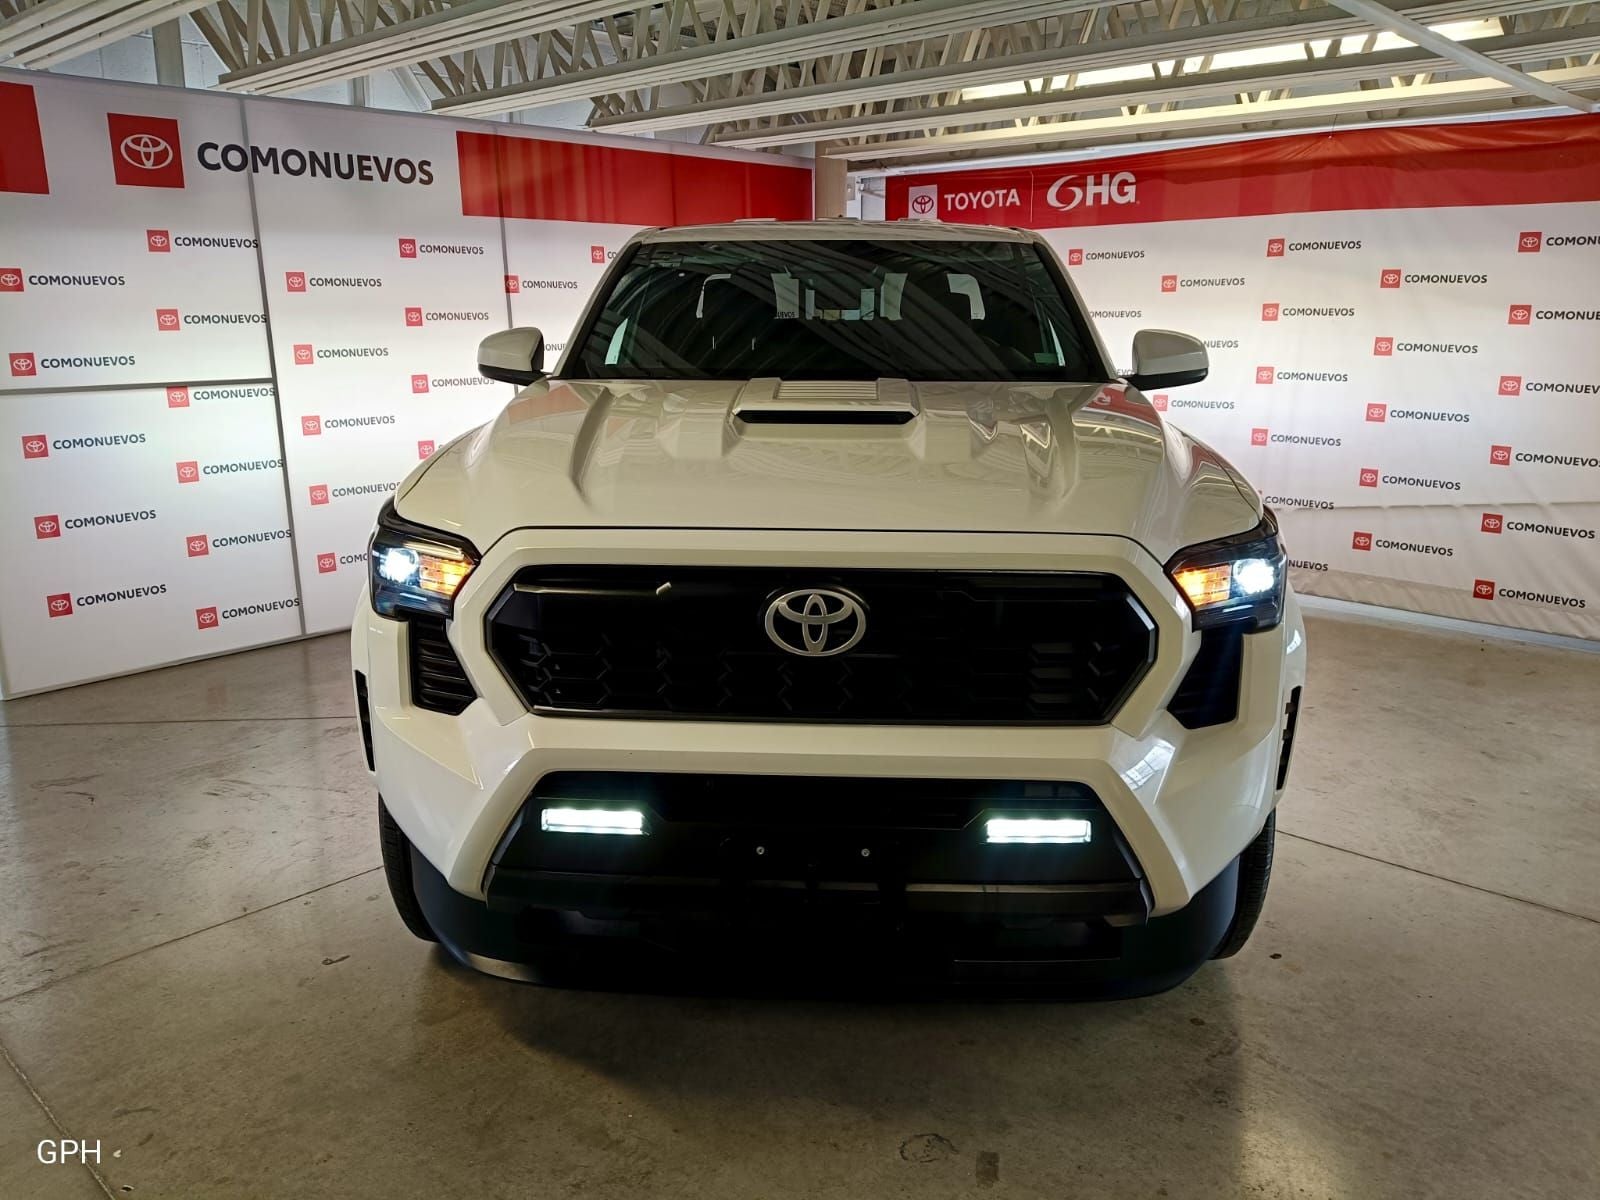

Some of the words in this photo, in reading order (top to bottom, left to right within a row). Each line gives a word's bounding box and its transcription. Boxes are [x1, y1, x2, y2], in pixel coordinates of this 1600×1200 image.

[198, 140, 434, 187] COMONUEVOS
[943, 188, 1021, 211] TOYOTA
[174, 236, 259, 250] COMONUEVOS
[419, 244, 485, 256] COMONUEVOS
[1288, 240, 1362, 252] COMONUEVOS
[1085, 250, 1145, 262] COMONUEVOS
[28, 274, 126, 287] COMONUEVOS
[309, 278, 383, 288] COMONUEVOS
[522, 280, 578, 290] COMONUEVOS
[1180, 277, 1245, 288] COMONUEVOS
[1404, 273, 1488, 286] COMONUEVOS
[425, 312, 490, 322] COMONUEVOS
[1282, 307, 1355, 317] COMONUEVOS
[184, 314, 267, 326] COMONUEVOS
[316, 347, 390, 359] COMONUEVOS
[1397, 342, 1479, 355] COMONUEVOS
[40, 355, 136, 369] COMONUEVOS
[1277, 371, 1348, 383] COMONUEVOS
[193, 386, 275, 401] COMONUEVOS
[1171, 399, 1235, 410] COMONUEVOS
[324, 414, 396, 429] COMONUEVOS
[1390, 409, 1470, 424] COMONUEVOS
[52, 433, 146, 450] COMONUEVOS
[1271, 433, 1342, 447] COMONUEVOS
[203, 459, 284, 475] COMONUEVOS
[1515, 452, 1600, 468] COMONUEVO
[1382, 474, 1462, 491] COMONUEVOS
[1264, 495, 1335, 511] COMONUEVOS
[64, 509, 157, 530] COMONUEVOS
[1506, 521, 1596, 540] COMONUEVOS
[212, 529, 292, 548] COMONUEVOS
[1375, 538, 1454, 557] COMONUEVOS
[76, 583, 167, 607] COMONUEVOS
[1498, 588, 1587, 609] COMONUEVOS
[222, 598, 301, 619] COMONUEVOS
